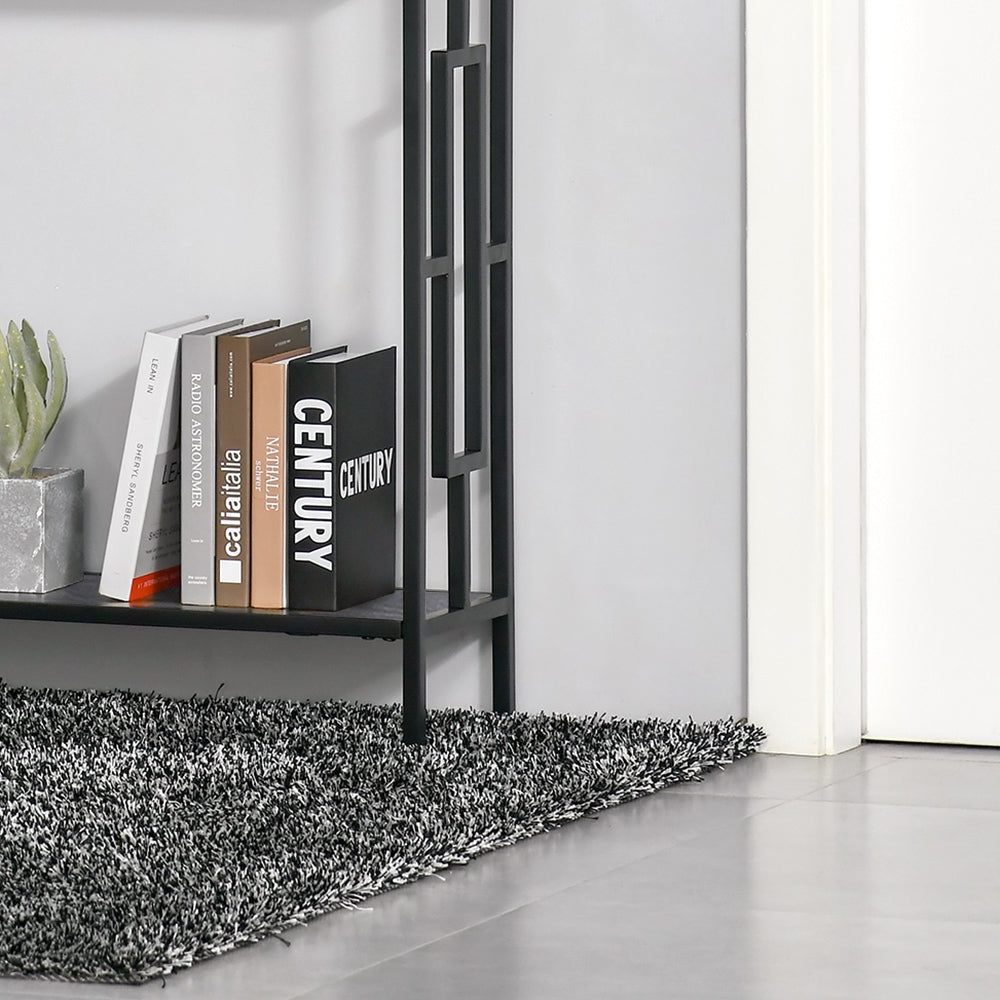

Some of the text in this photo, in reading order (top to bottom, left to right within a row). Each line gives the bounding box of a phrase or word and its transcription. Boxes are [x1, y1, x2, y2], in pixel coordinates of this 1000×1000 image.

[146, 358, 159, 394] LEAN IN
[191, 373, 203, 508] RADIO ASTRONOMER
[265, 436, 280, 511] NATHALIE
[293, 398, 333, 571] CENTURY
[339, 448, 394, 499] CENTURY
[121, 443, 144, 533] SHERYL SANDBERG
[220, 449, 241, 557] caliaitalia
